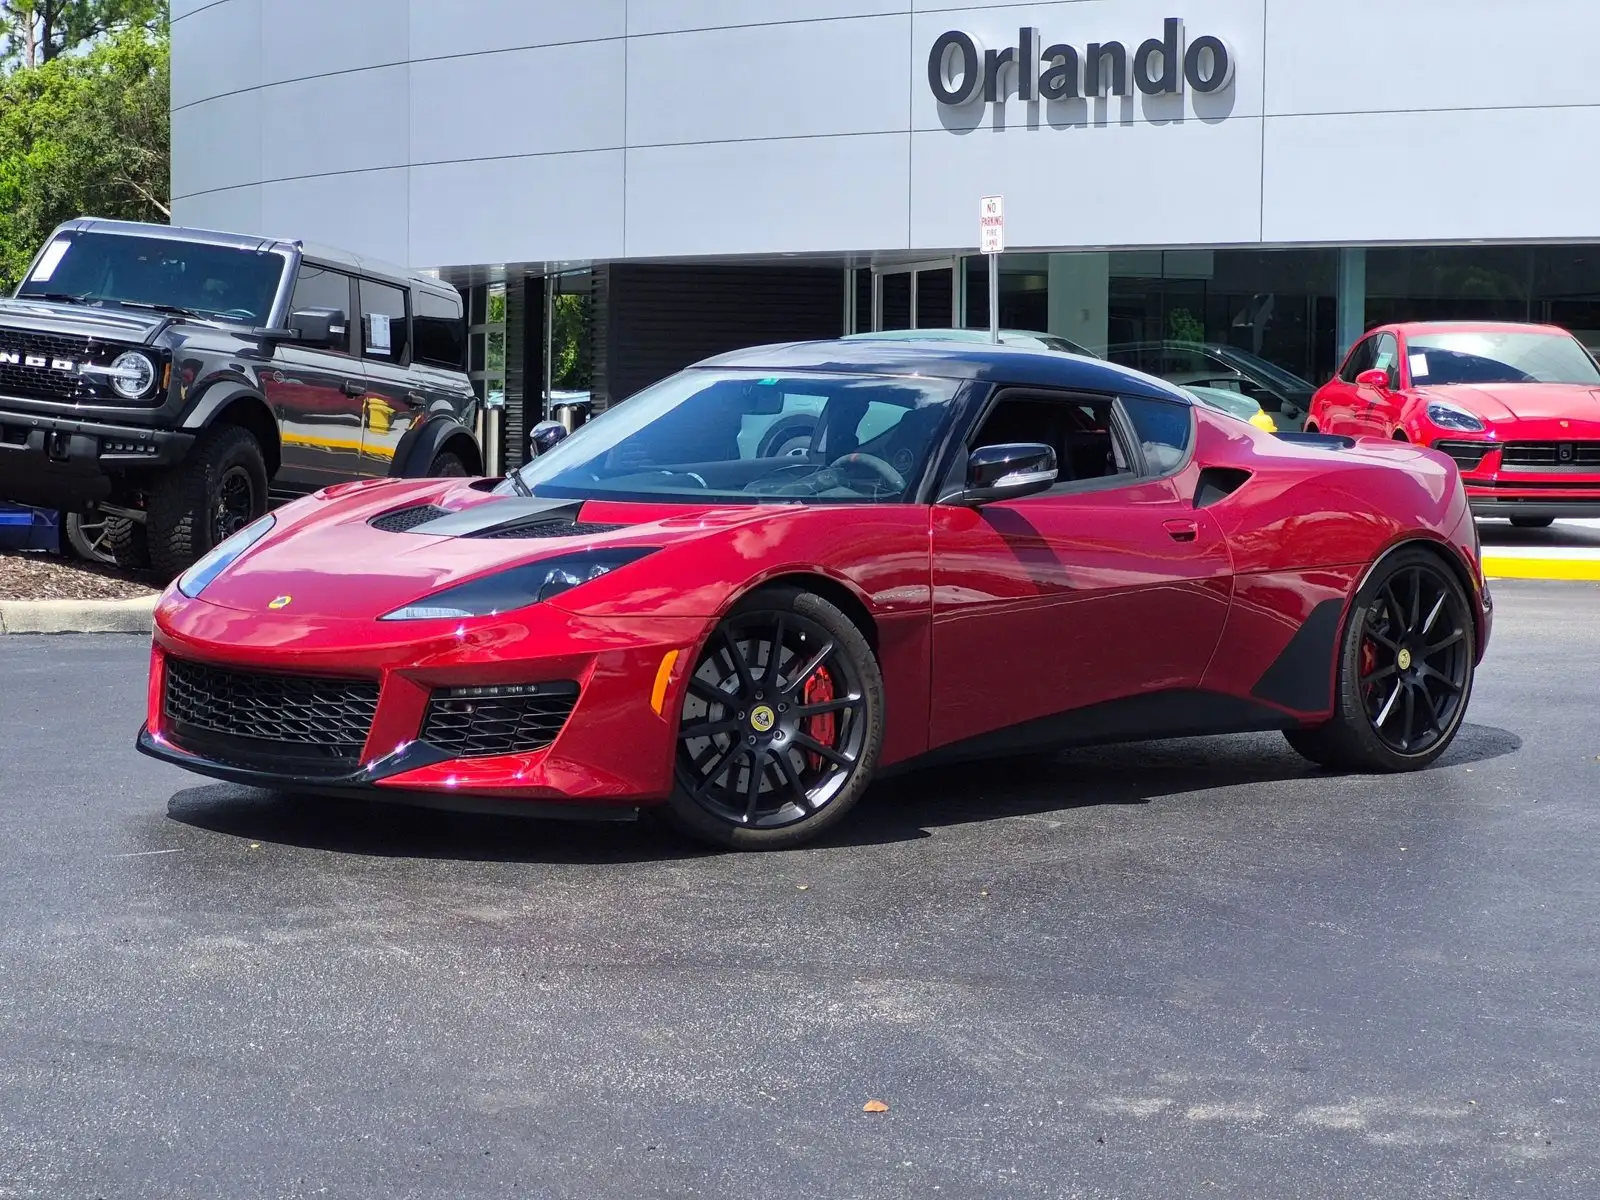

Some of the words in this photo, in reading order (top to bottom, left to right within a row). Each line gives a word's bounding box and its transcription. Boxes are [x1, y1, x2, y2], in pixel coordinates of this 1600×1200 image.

[928, 18, 1234, 106] Orlando
[987, 203, 996, 213] NO
[981, 216, 1003, 226] PARKING
[986, 229, 998, 237] FIRE
[986, 239, 998, 247] LANE
